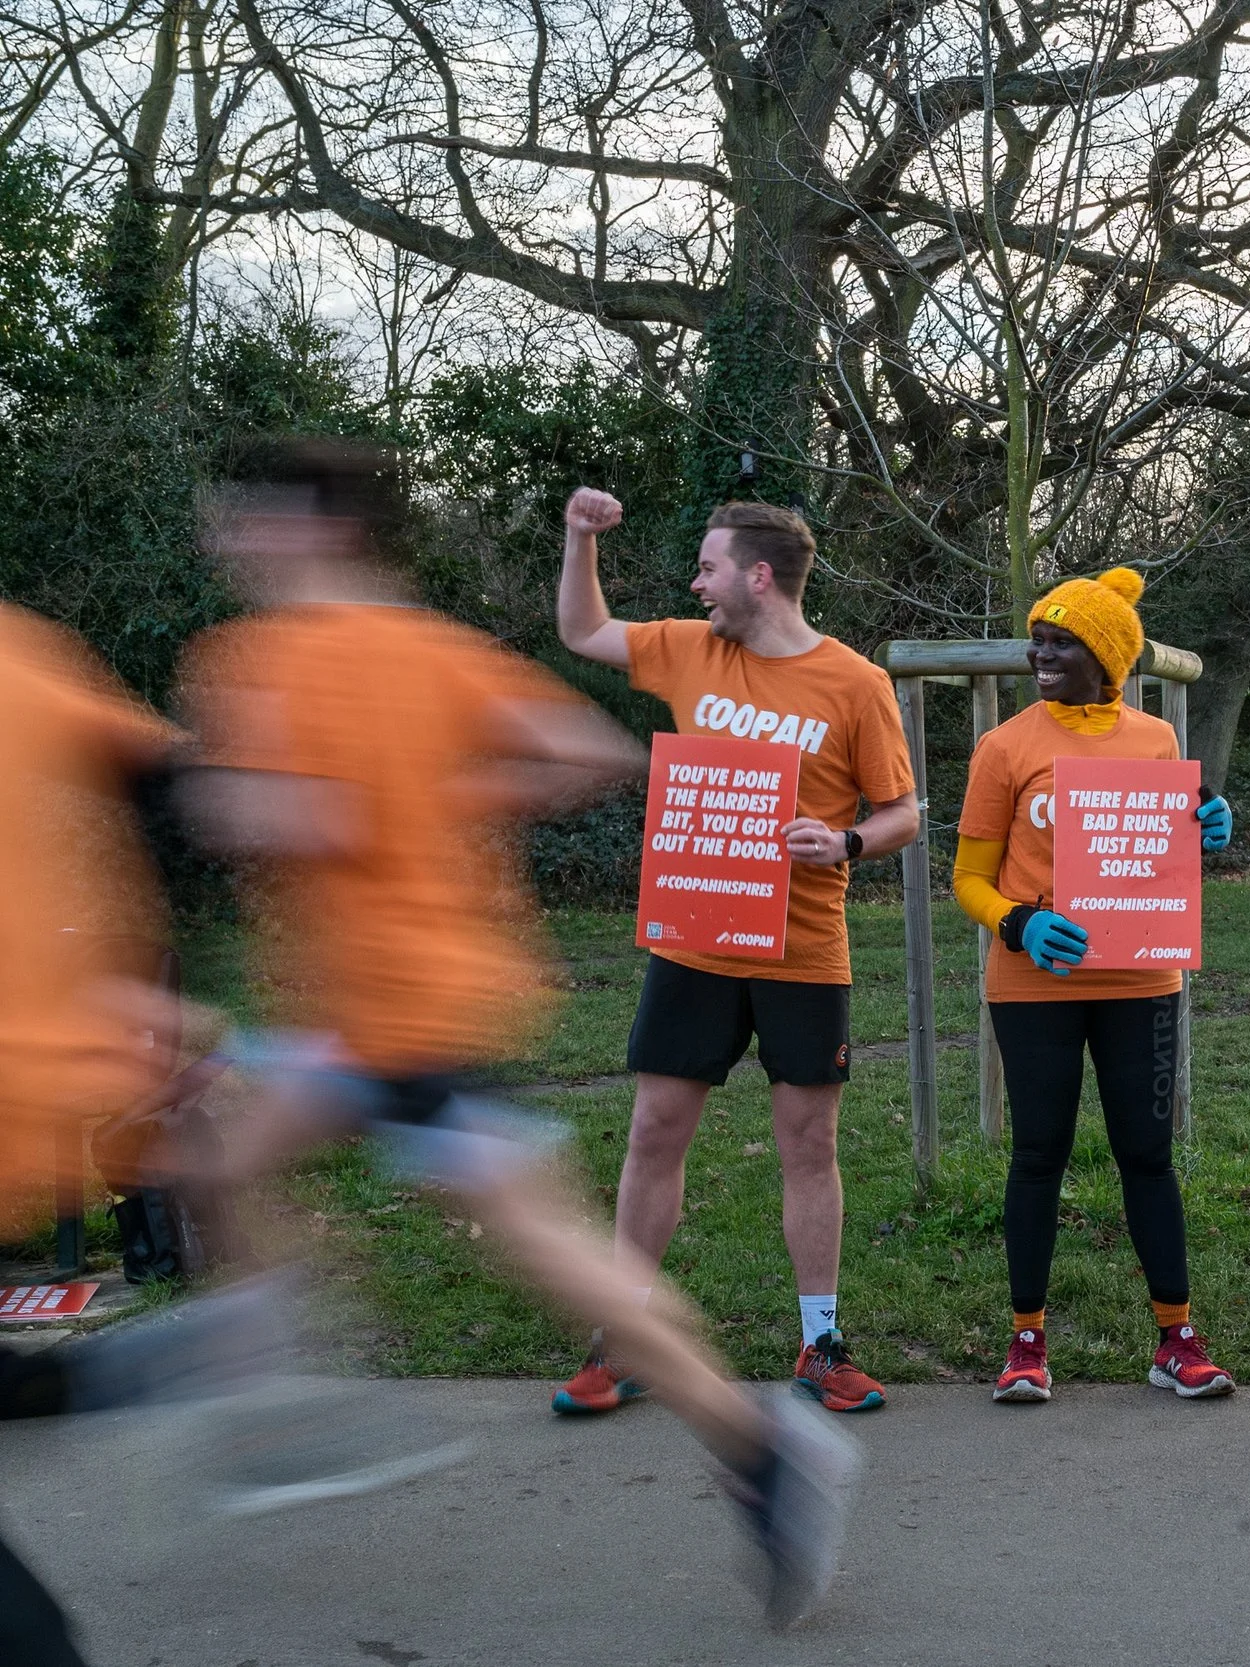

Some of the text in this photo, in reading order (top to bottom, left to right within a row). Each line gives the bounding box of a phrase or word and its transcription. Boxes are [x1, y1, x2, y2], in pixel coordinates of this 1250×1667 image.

[694, 694, 829, 755] COOPAH
[668, 764, 781, 790] YOU'VE DONE
[665, 788, 779, 814] THE HARDEST
[1069, 790, 1188, 810] THERE ARE NO
[661, 813, 779, 837] BIT, YOU GOT
[1082, 814, 1173, 835] BAD RUNS,
[651, 833, 782, 862] OUT THE DOOR.
[1087, 837, 1169, 855] JUST BAD
[1099, 860, 1156, 877] SOFAS.
[656, 875, 774, 898] #COOPAHINSPIRES
[1069, 897, 1187, 912] #COOPAHINSPIRES
[732, 933, 774, 947] COOPAH
[1150, 948, 1192, 959] COOPAH
